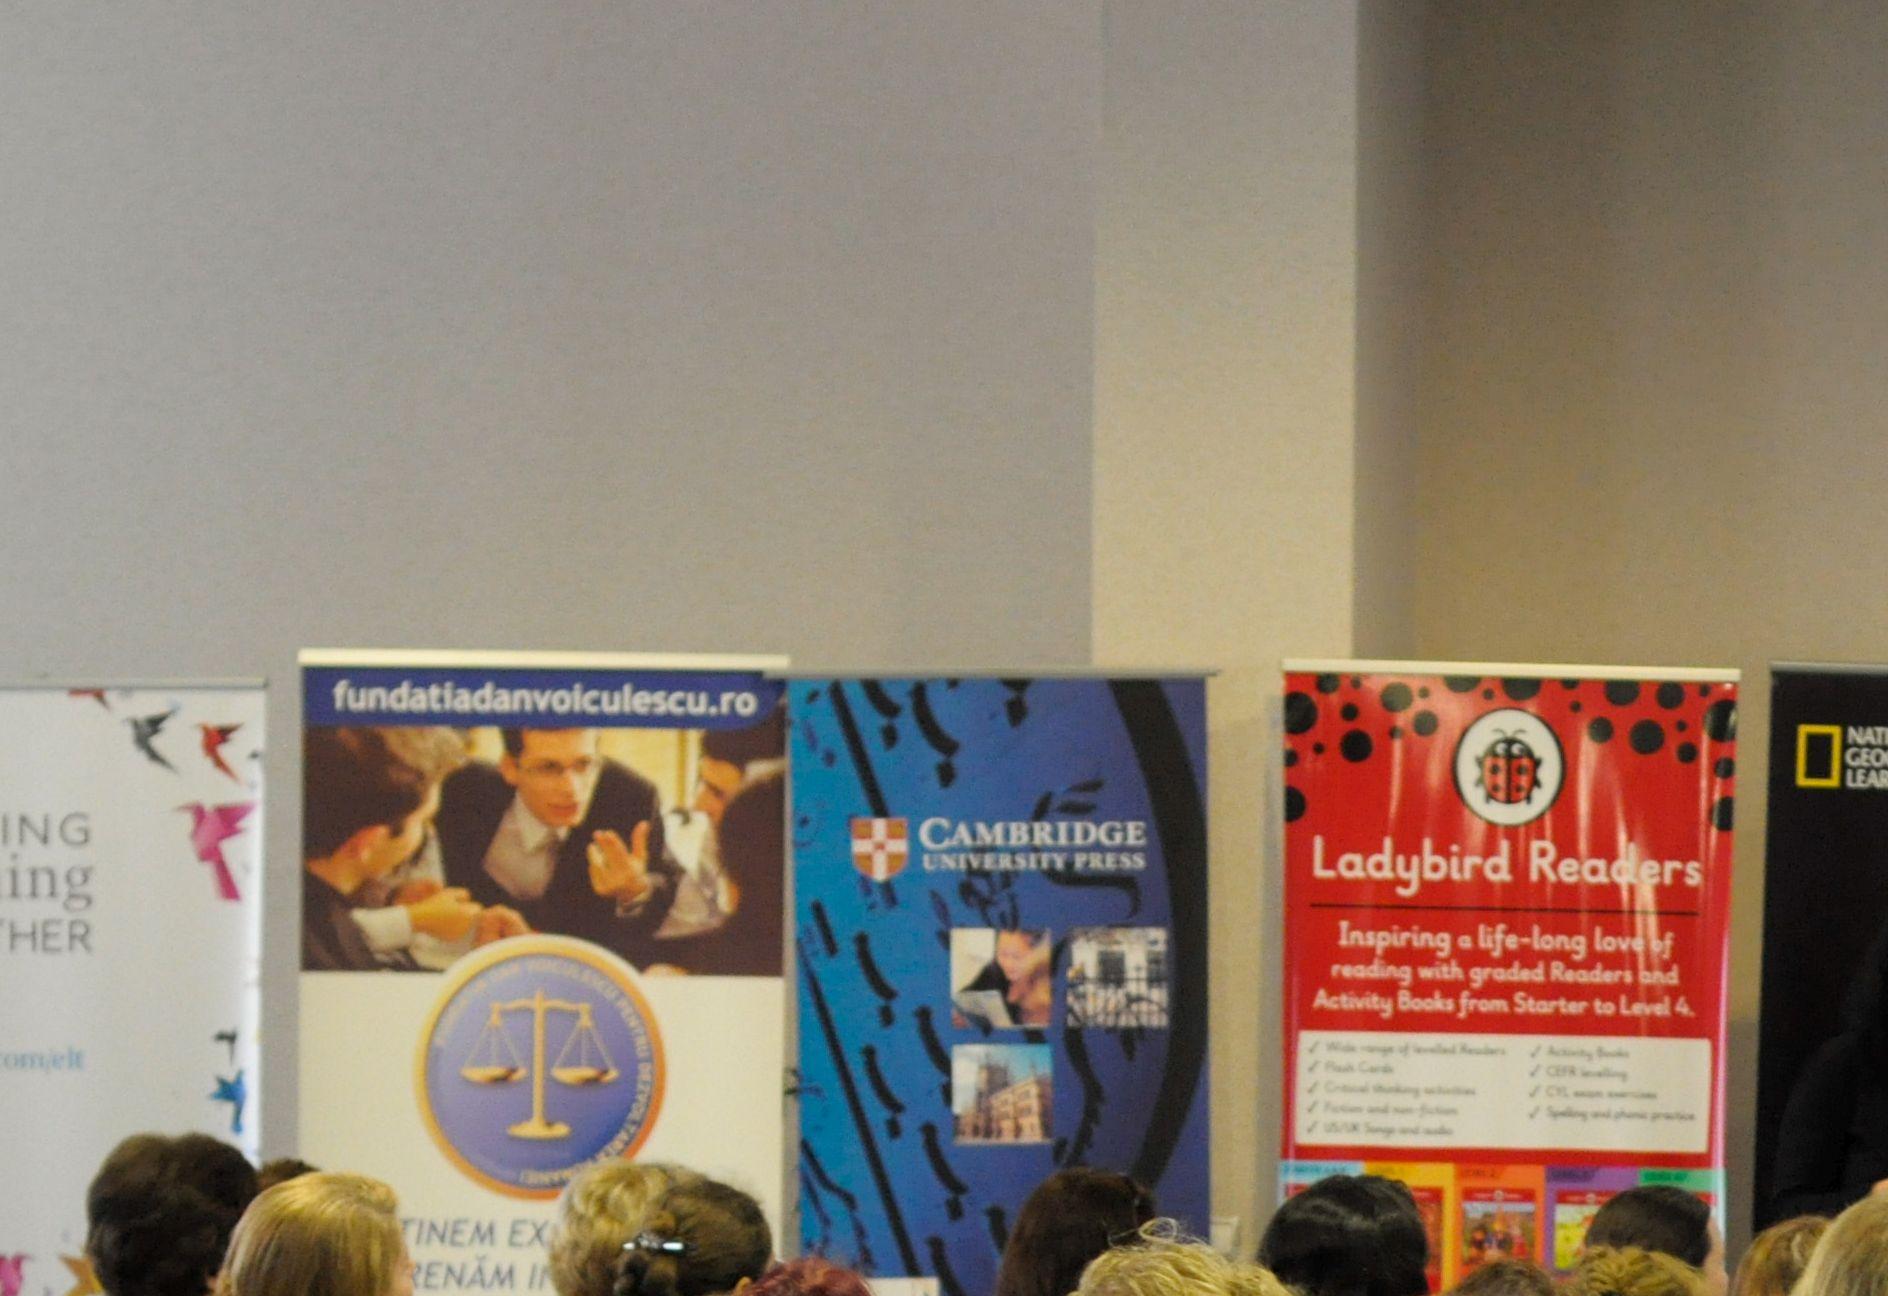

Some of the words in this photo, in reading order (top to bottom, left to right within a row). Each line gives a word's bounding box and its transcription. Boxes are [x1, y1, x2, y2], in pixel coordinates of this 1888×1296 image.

[333, 679, 758, 717] fundatiadanvoiculescu.ro
[0, 812, 90, 847] ING
[919, 817, 1147, 850] CAMBRIDGE
[922, 852, 1068, 871] UNIVERSITY
[1074, 852, 1146, 870] PRESS
[1312, 835, 1512, 897] Ladybird
[1529, 840, 1702, 887] Readers
[0, 853, 93, 913] ing
[0, 918, 93, 953] HER
[1338, 921, 1451, 957] Inspiring
[1457, 935, 1472, 949] a
[1477, 925, 1587, 960] life-long
[1594, 927, 1644, 952] love
[1650, 932, 1675, 959] of
[1331, 958, 1412, 986] reading
[1418, 959, 1464, 981] with
[1470, 960, 1544, 988] graded
[1551, 962, 1633, 985] Readers
[1639, 964, 1679, 985] and
[1313, 989, 1393, 1018] Activity
[1399, 990, 1454, 1012] Books
[1458, 990, 1508, 1018] from
[1514, 992, 1589, 1014] Starter
[1594, 997, 1616, 1016] to
[1620, 995, 1670, 1017] Level
